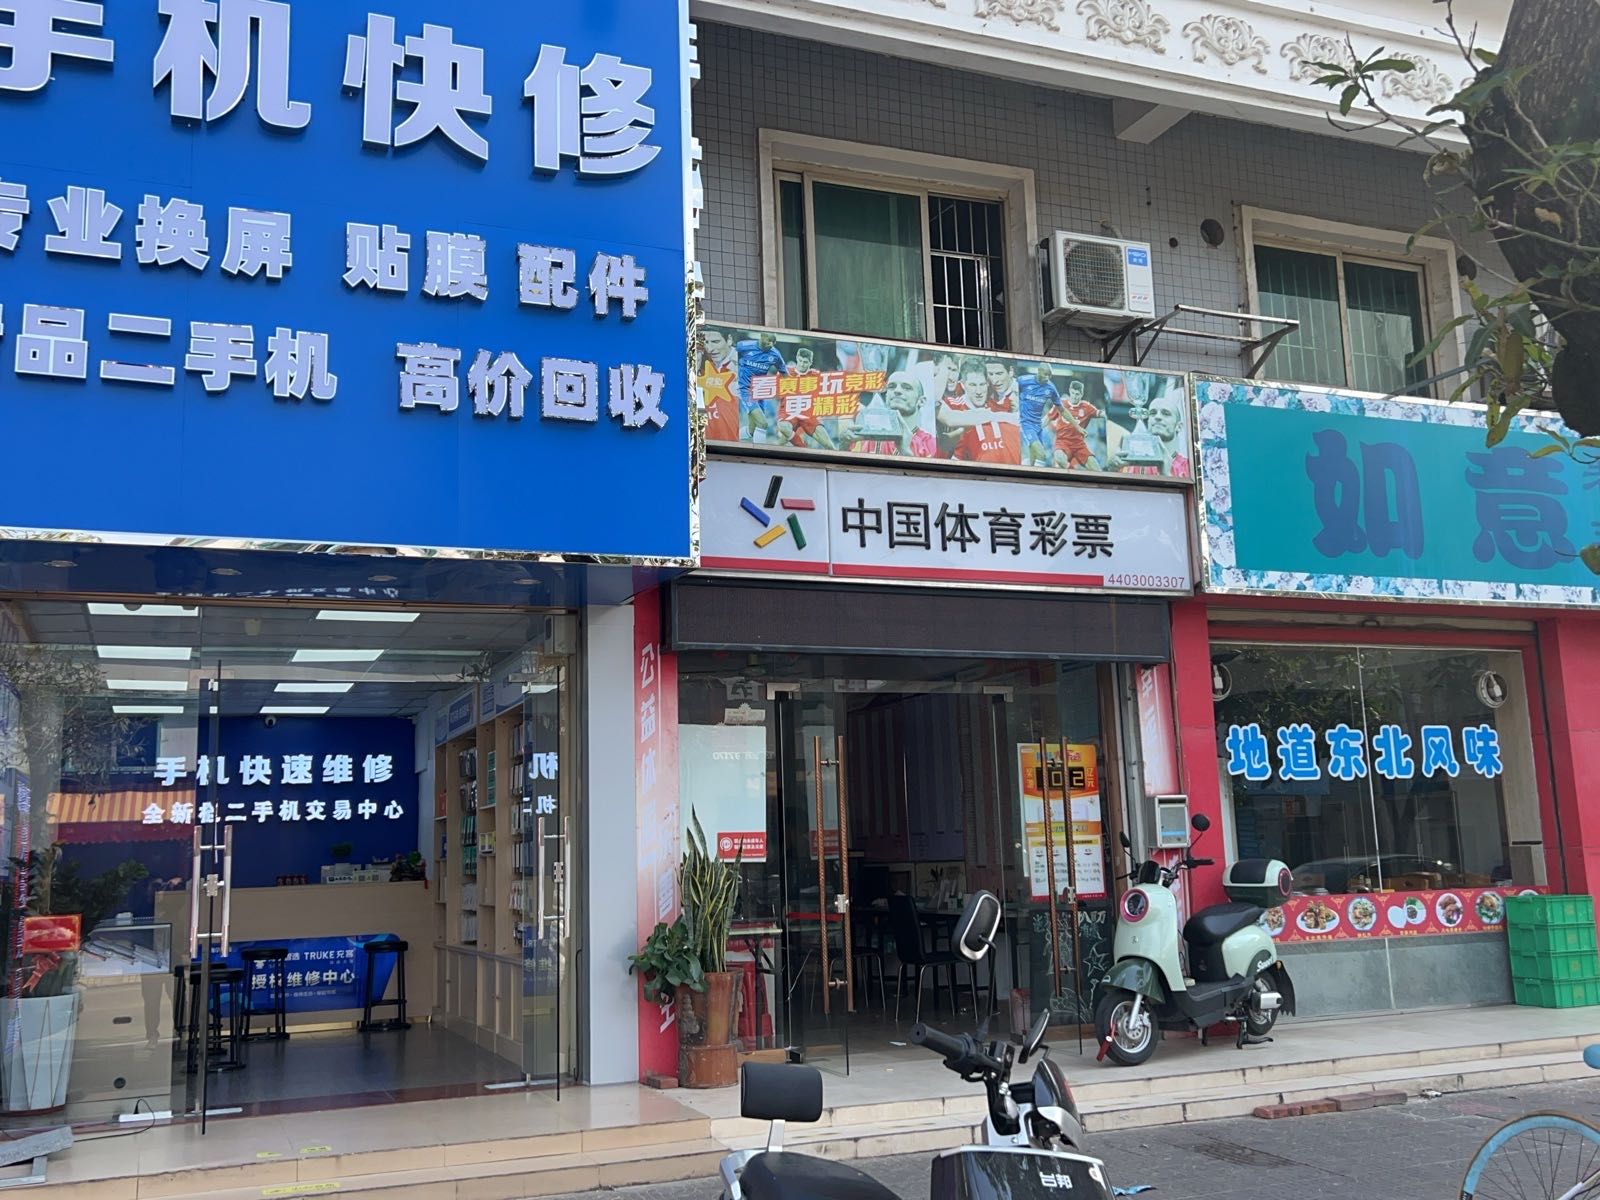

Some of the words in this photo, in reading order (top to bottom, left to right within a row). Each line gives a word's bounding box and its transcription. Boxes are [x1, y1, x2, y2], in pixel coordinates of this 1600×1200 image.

[343, 222, 489, 301] 贴膜
[516, 243, 649, 318] 配件
[0, 303, 338, 402] 品二手机
[396, 342, 669, 430] 高价回收
[752, 371, 886, 400] 看赛事玩竞彩
[785, 394, 861, 421] 更精彩
[1306, 428, 1600, 571] 如意
[841, 497, 1115, 560] 中国体育彩票
[1107, 572, 1186, 589] 4403003307
[154, 754, 394, 787] 手机快速维修
[1226, 723, 1504, 782] 地道东北风味
[142, 799, 404, 825] 全新机二手机交易中心
